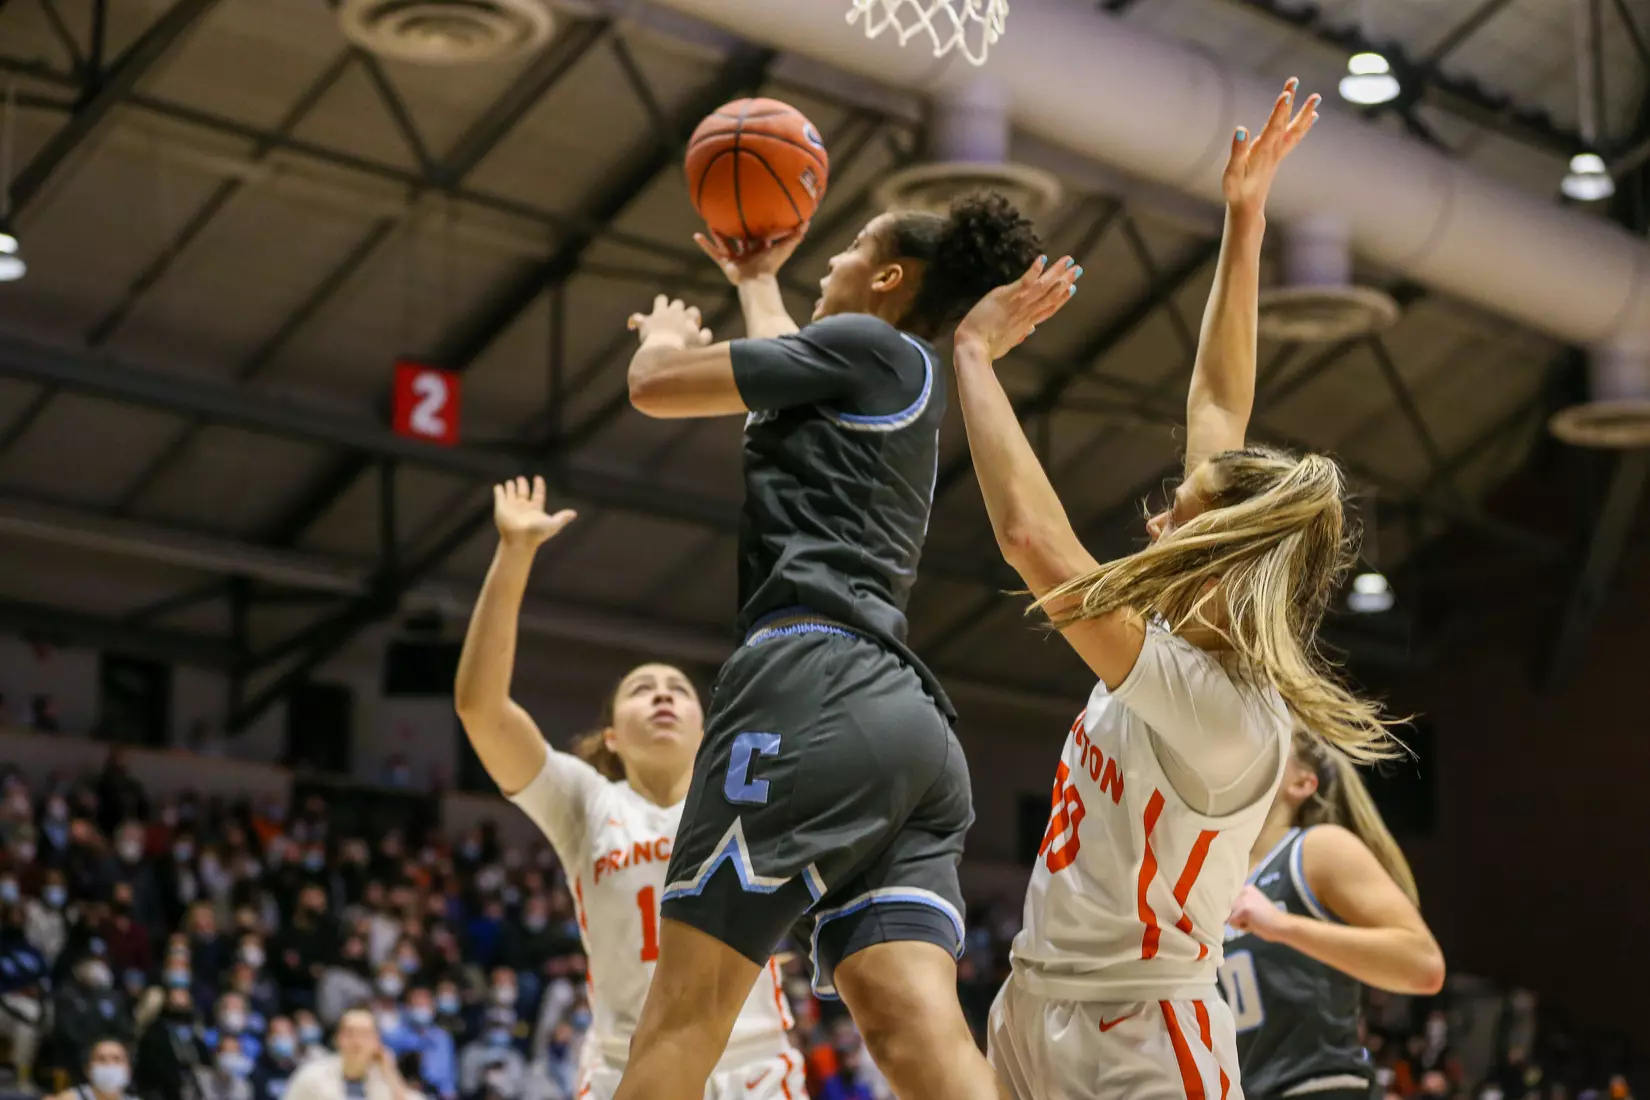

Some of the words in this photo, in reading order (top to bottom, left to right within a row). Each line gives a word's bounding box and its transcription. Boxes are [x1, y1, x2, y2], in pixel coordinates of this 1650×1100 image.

[410, 371, 448, 437] 2
[724, 731, 782, 805] C
[594, 836, 671, 885] PRINC
[636, 885, 660, 962] 1
